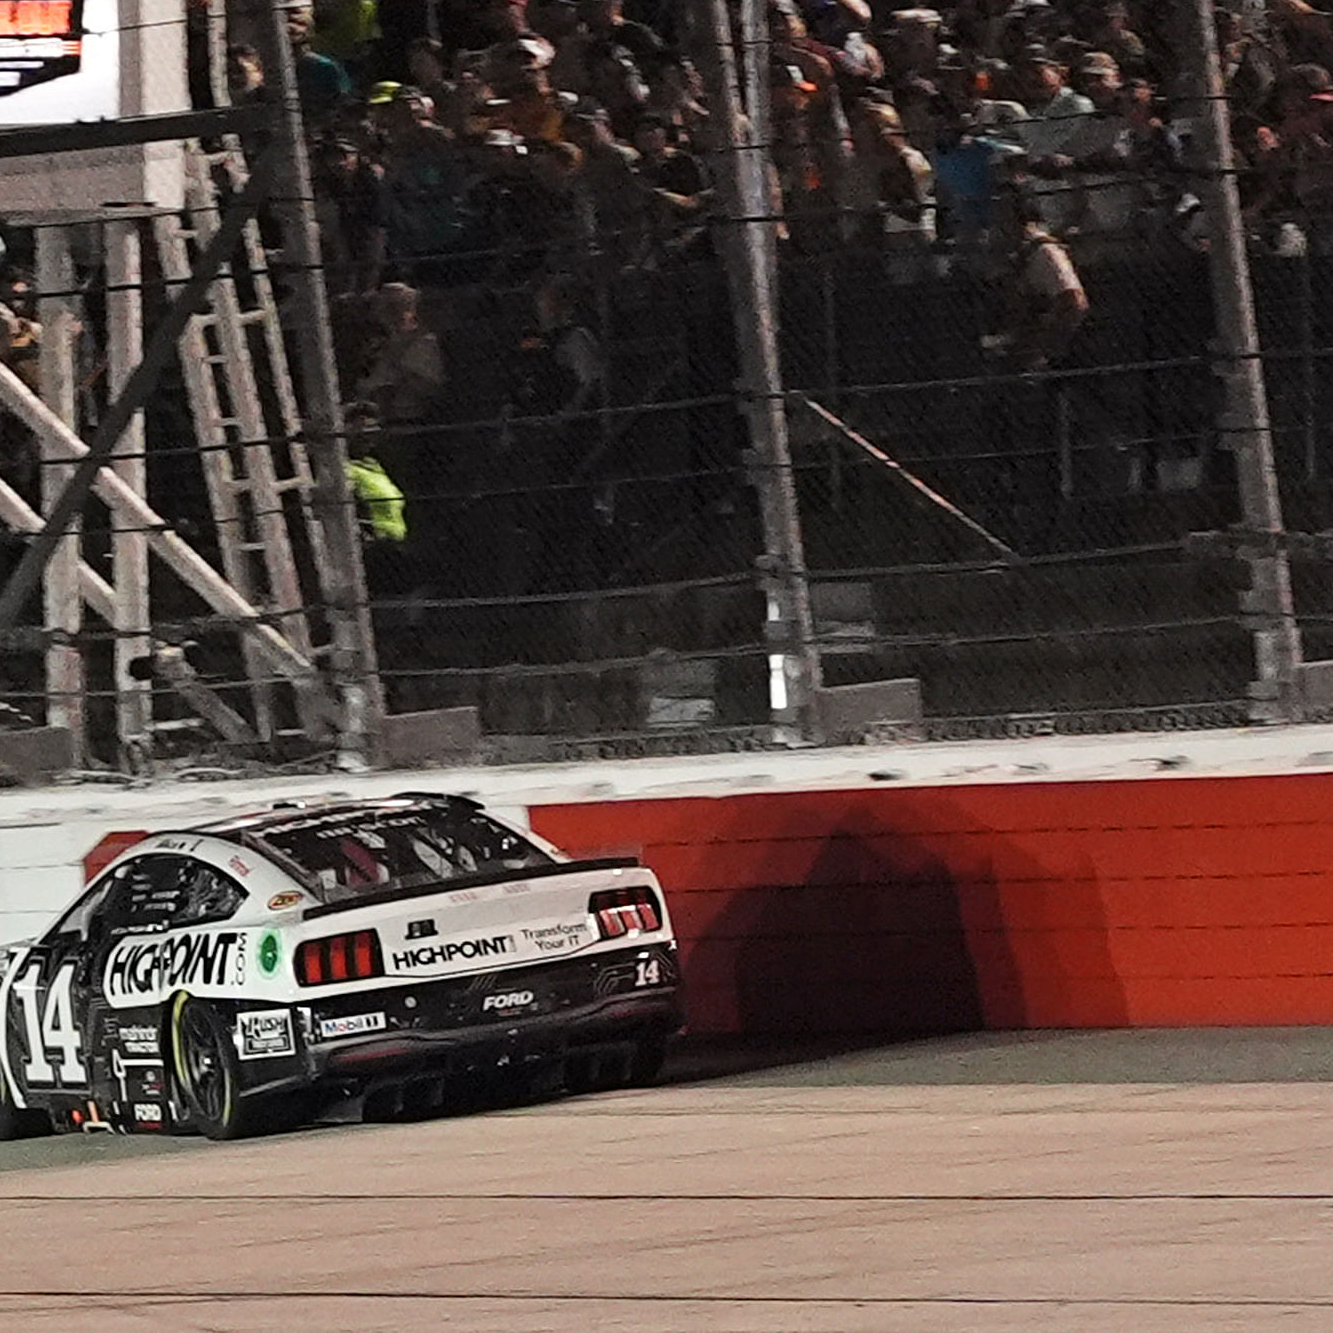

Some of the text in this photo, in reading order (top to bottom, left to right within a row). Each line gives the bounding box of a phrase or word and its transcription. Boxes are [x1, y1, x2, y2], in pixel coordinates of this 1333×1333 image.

[520, 923, 588, 940] Transform
[534, 934, 580, 951] Your IT
[392, 935, 509, 970] HIGHPOINT
[634, 959, 660, 987] 14
[483, 990, 534, 1012] FORD
[12, 963, 88, 1082] 14
[324, 1017, 363, 1033] Mobil
